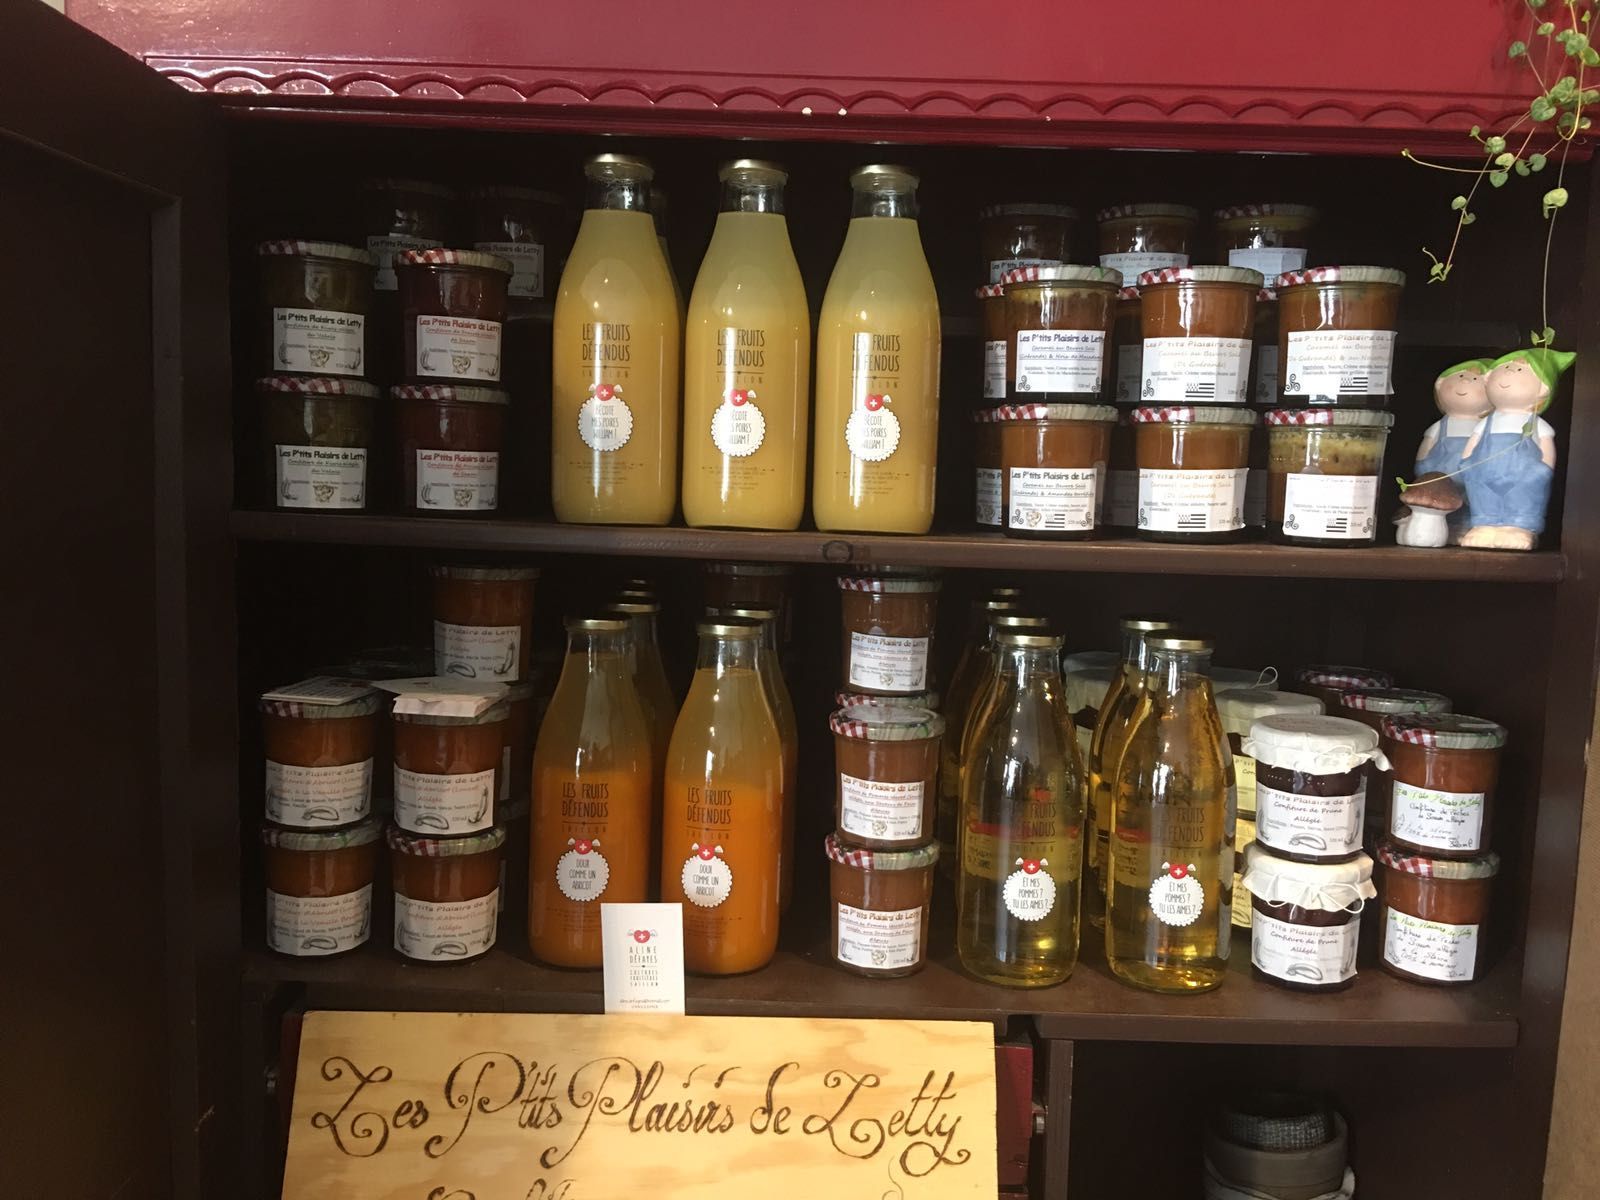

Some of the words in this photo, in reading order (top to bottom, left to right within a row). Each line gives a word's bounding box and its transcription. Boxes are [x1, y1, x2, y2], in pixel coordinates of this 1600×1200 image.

[276, 313, 288, 321] Les
[308, 314, 336, 324] Plaisirs
[336, 317, 346, 325] de
[418, 318, 430, 326] Les
[452, 320, 477, 329] Plaisirs
[478, 322, 486, 330] de
[602, 323, 631, 341] FRUITS
[736, 329, 766, 347] FRUITS
[872, 334, 900, 352] FRUITS
[1020, 334, 1030, 342] Les
[1032, 333, 1052, 342] P'tits
[1054, 334, 1080, 343] Plaisirs
[1082, 334, 1090, 343] de
[280, 449, 291, 457] Les
[314, 451, 340, 460] Plaisirs
[420, 452, 432, 461] Les
[454, 454, 478, 462] Plaisirs
[1012, 471, 1021, 479] Les
[1022, 470, 1042, 479] P'tits
[1043, 472, 1069, 480] Plaisirs
[1070, 472, 1080, 480] de
[903, 640, 912, 648] de
[562, 782, 576, 799] LES
[582, 783, 609, 800] FRUITS
[870, 783, 896, 792] Plaisirs
[688, 787, 701, 804] LES
[704, 789, 732, 806] FRUITS
[1292, 797, 1330, 806] Plaisirs
[562, 799, 609, 818] DÉFENDUS
[1274, 801, 1308, 812] Confiture
[1320, 807, 1344, 815] Prune
[686, 803, 732, 825] DÉFENDUS
[568, 869, 588, 879] COMME
[588, 870, 597, 880] UN
[692, 874, 710, 886] COMME
[710, 876, 720, 887] UN
[1022, 877, 1029, 888] ET
[1030, 878, 1041, 888] MES
[1169, 881, 1176, 892] ET
[1176, 882, 1188, 893] MES
[1018, 888, 1040, 899] POMMES
[1164, 892, 1186, 904] POMMES
[436, 904, 471, 912] Plaisirs
[474, 901, 484, 909] de
[1020, 899, 1030, 910] LES
[1030, 899, 1044, 910] AIMES
[1166, 904, 1176, 914] LES
[1176, 904, 1192, 915] AIMES
[868, 912, 894, 921] Plaisirs
[895, 911, 904, 921] de
[1270, 931, 1304, 943] Confiture
[628, 946, 657, 954] ALINE
[310, 1057, 430, 1157] Les
[424, 1052, 564, 1159] P'tits
[540, 1057, 740, 1169] Plaisirs
[750, 1062, 800, 1135] de
[802, 1070, 972, 1177] Letty
